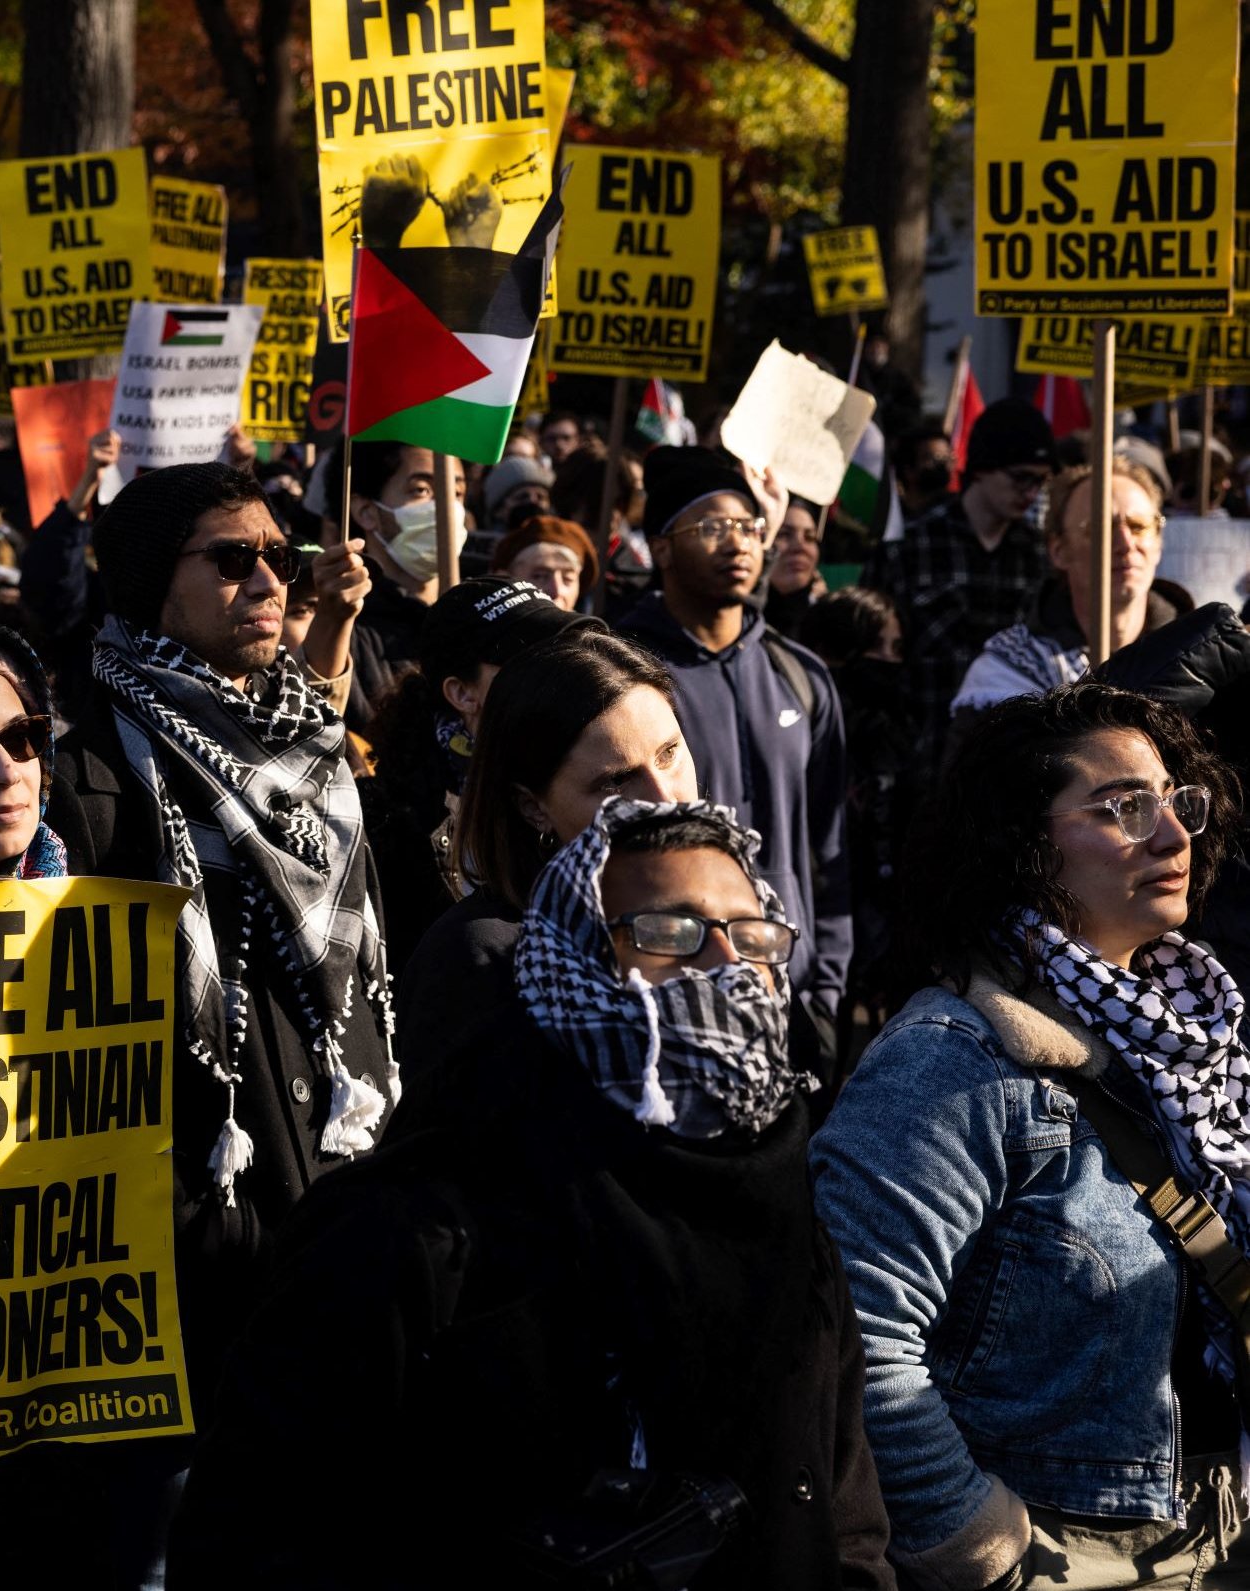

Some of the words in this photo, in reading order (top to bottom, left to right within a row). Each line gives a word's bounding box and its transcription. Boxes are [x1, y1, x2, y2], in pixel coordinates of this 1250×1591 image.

[1034, 0, 1175, 60] END
[321, 62, 544, 139] PALESTINE
[1040, 62, 1165, 141] ALL
[25, 157, 118, 217] END
[598, 155, 693, 217] END
[987, 160, 1095, 224] U.S.
[1111, 157, 1217, 223] AID
[51, 216, 103, 252] ALL
[615, 221, 671, 258] ALL
[983, 233, 1032, 280] TO
[1046, 230, 1218, 280] ISRAEL!
[23, 266, 78, 300] U.S.
[84, 259, 134, 294] AID
[577, 268, 639, 305] U.S.
[643, 274, 694, 311] AID
[13, 307, 46, 337] TO
[52, 297, 136, 332] ISRAE
[561, 311, 595, 343] TO
[601, 315, 705, 350] ISRAEL!
[127, 353, 181, 371] ISRAEL
[275, 352, 289, 375] A
[116, 412, 166, 431] MANY
[474, 586, 515, 611] MAKE
[482, 592, 532, 621] WRONG
[45, 902, 165, 1033] ALL
[24, 1390, 170, 1431] Coalition
